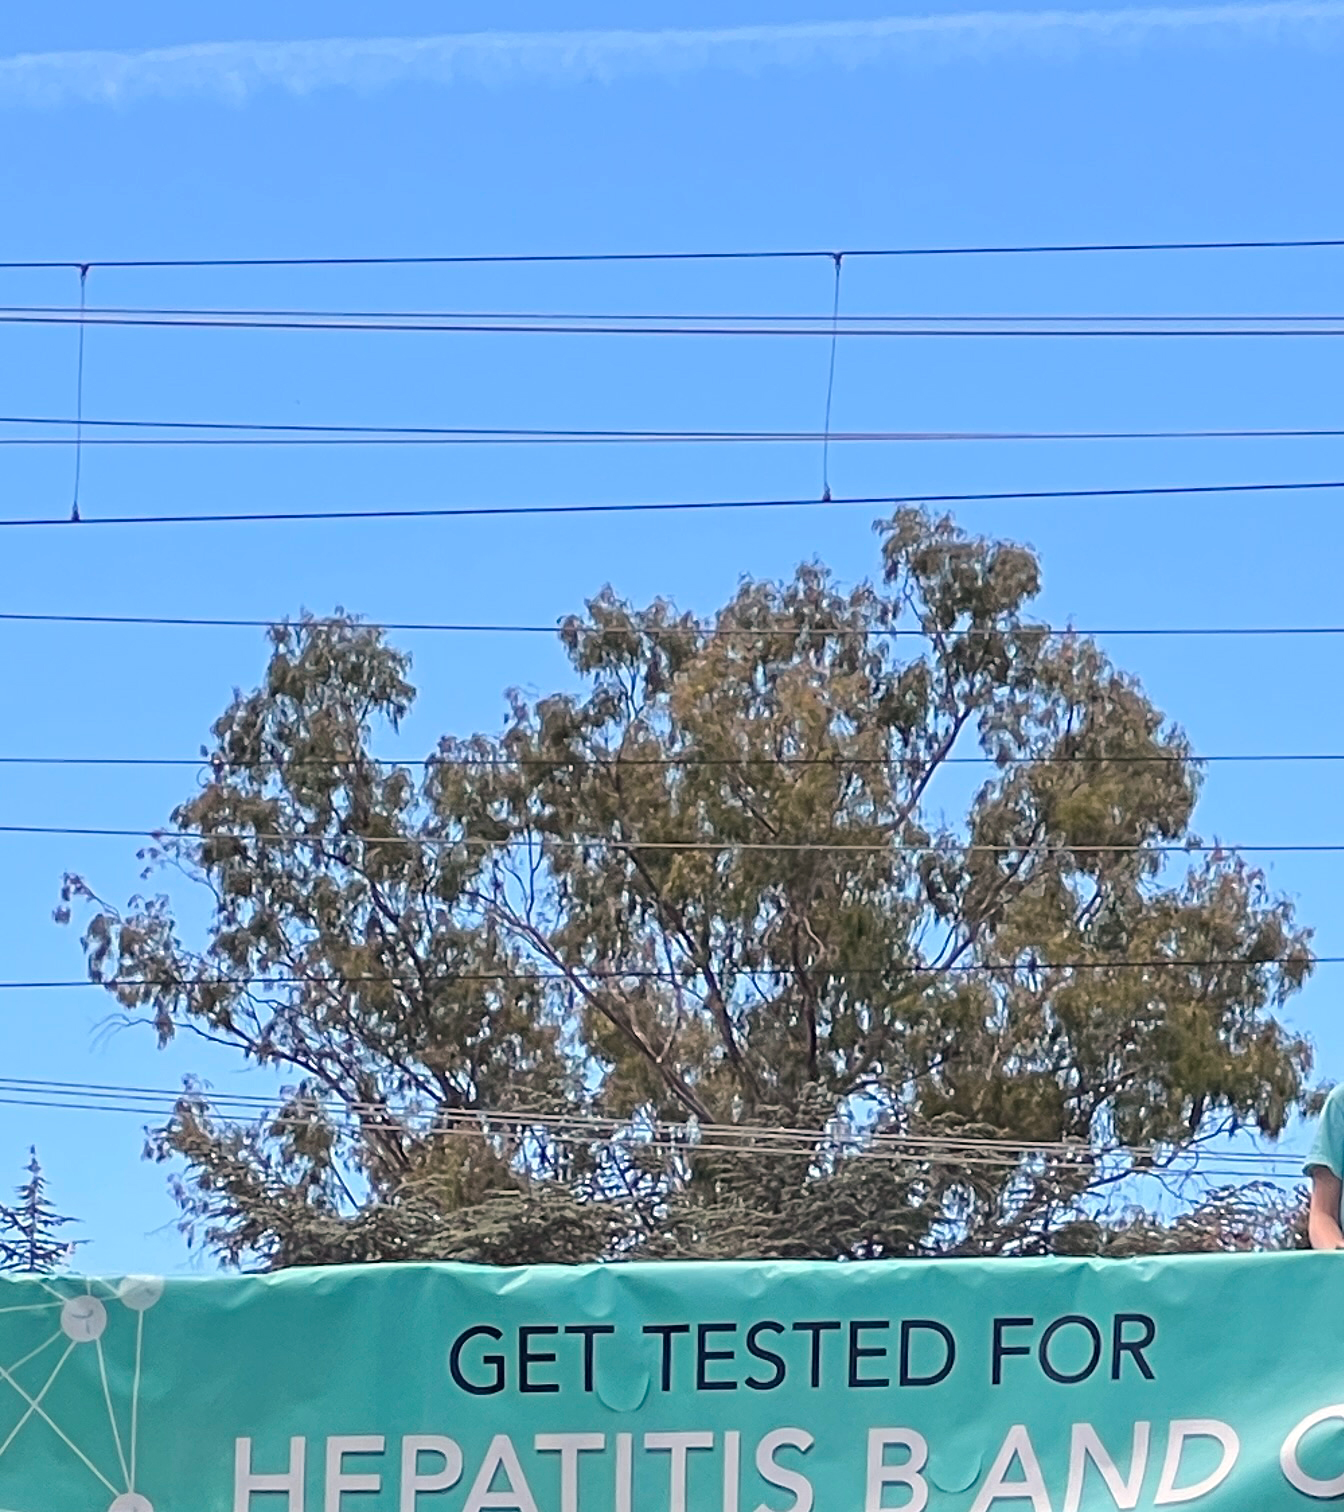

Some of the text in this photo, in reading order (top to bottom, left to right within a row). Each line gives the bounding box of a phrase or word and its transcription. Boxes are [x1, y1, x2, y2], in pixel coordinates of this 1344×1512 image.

[449, 1313, 1157, 1396] GET TESTED FOR
